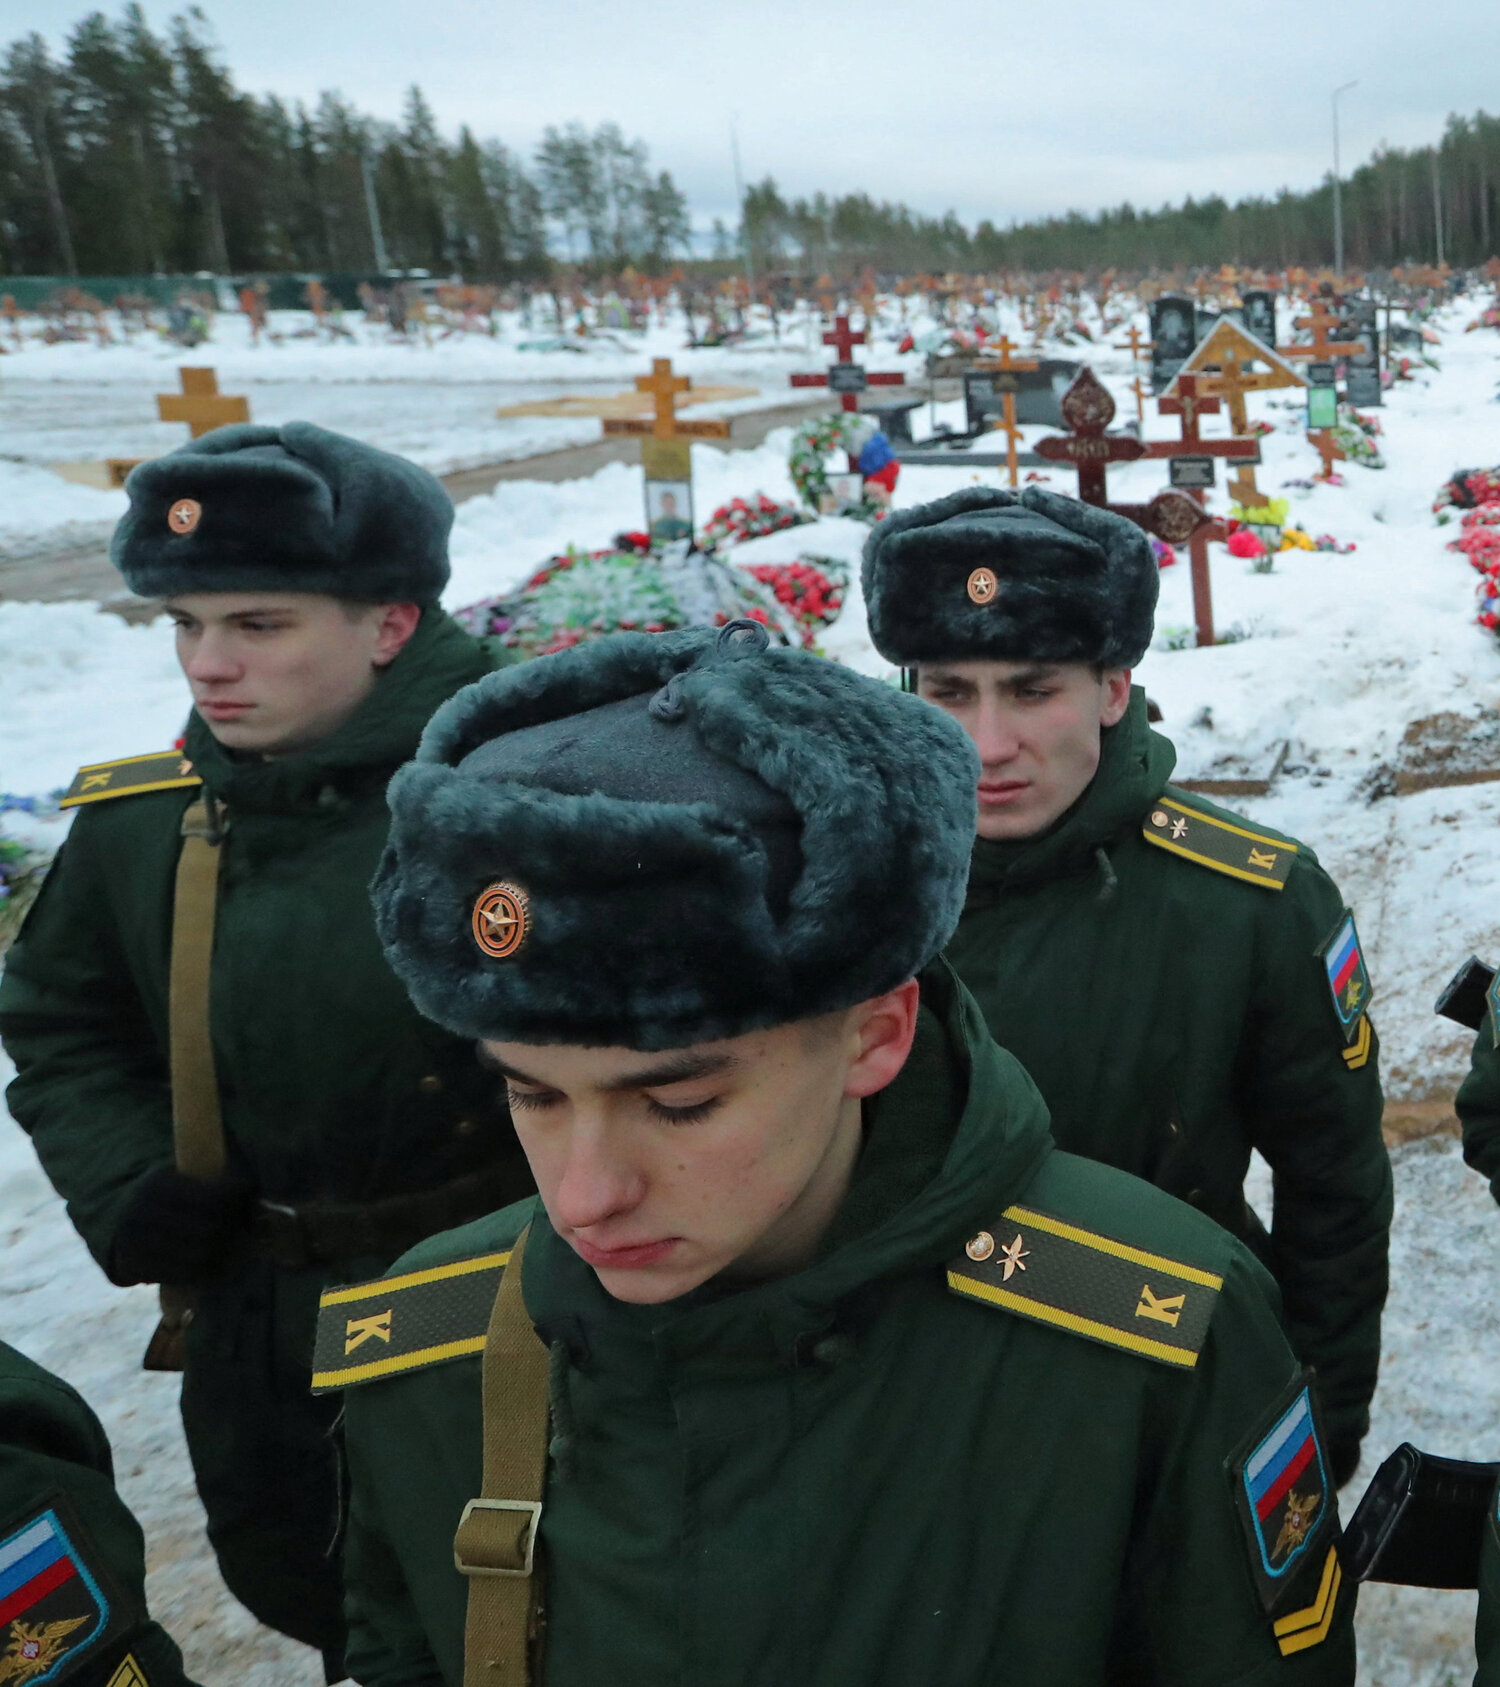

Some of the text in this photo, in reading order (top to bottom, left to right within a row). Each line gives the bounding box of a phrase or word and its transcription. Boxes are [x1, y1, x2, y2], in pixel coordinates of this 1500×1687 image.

[81, 772, 112, 791] К
[1248, 848, 1277, 870] К
[1136, 1285, 1187, 1327] К
[345, 1309, 393, 1355] К
